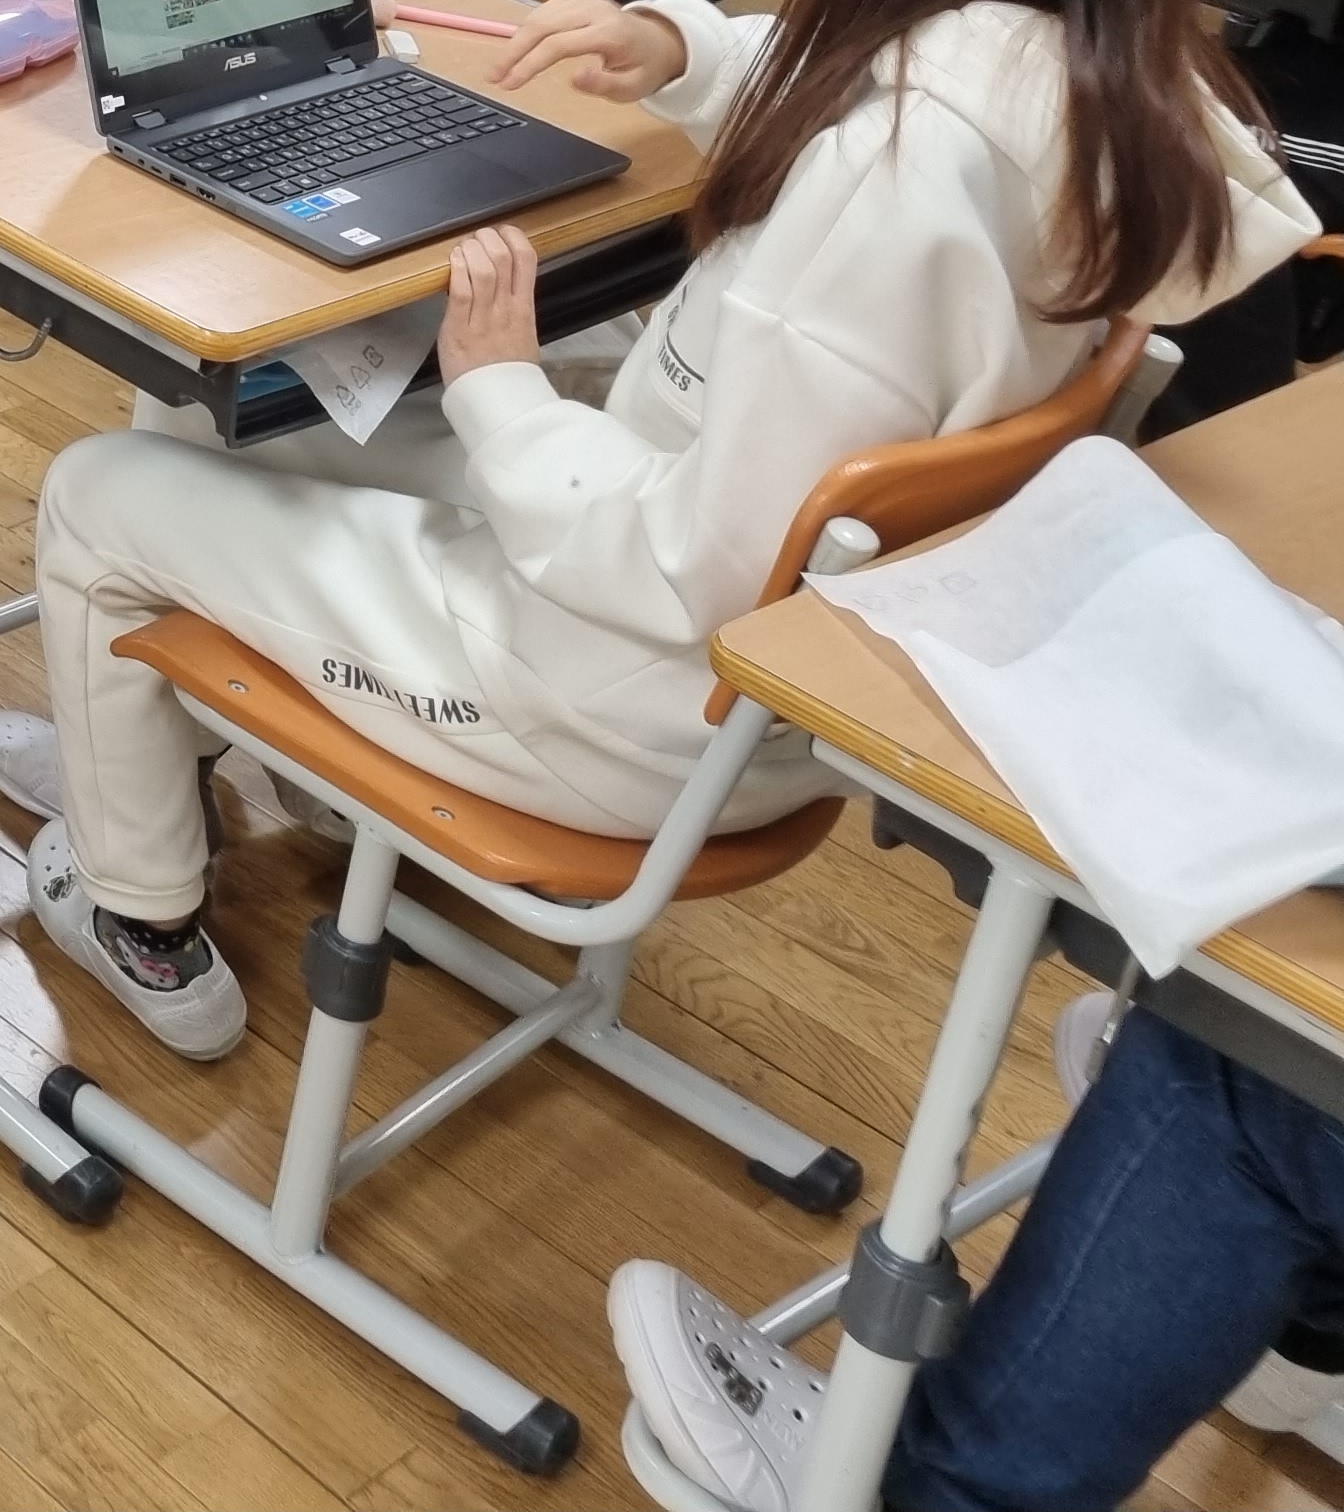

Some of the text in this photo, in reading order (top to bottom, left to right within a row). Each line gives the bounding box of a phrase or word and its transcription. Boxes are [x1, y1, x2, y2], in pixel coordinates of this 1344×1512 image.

[224, 52, 257, 71] ASUS
[321, 658, 481, 724] SWEET TIMES
